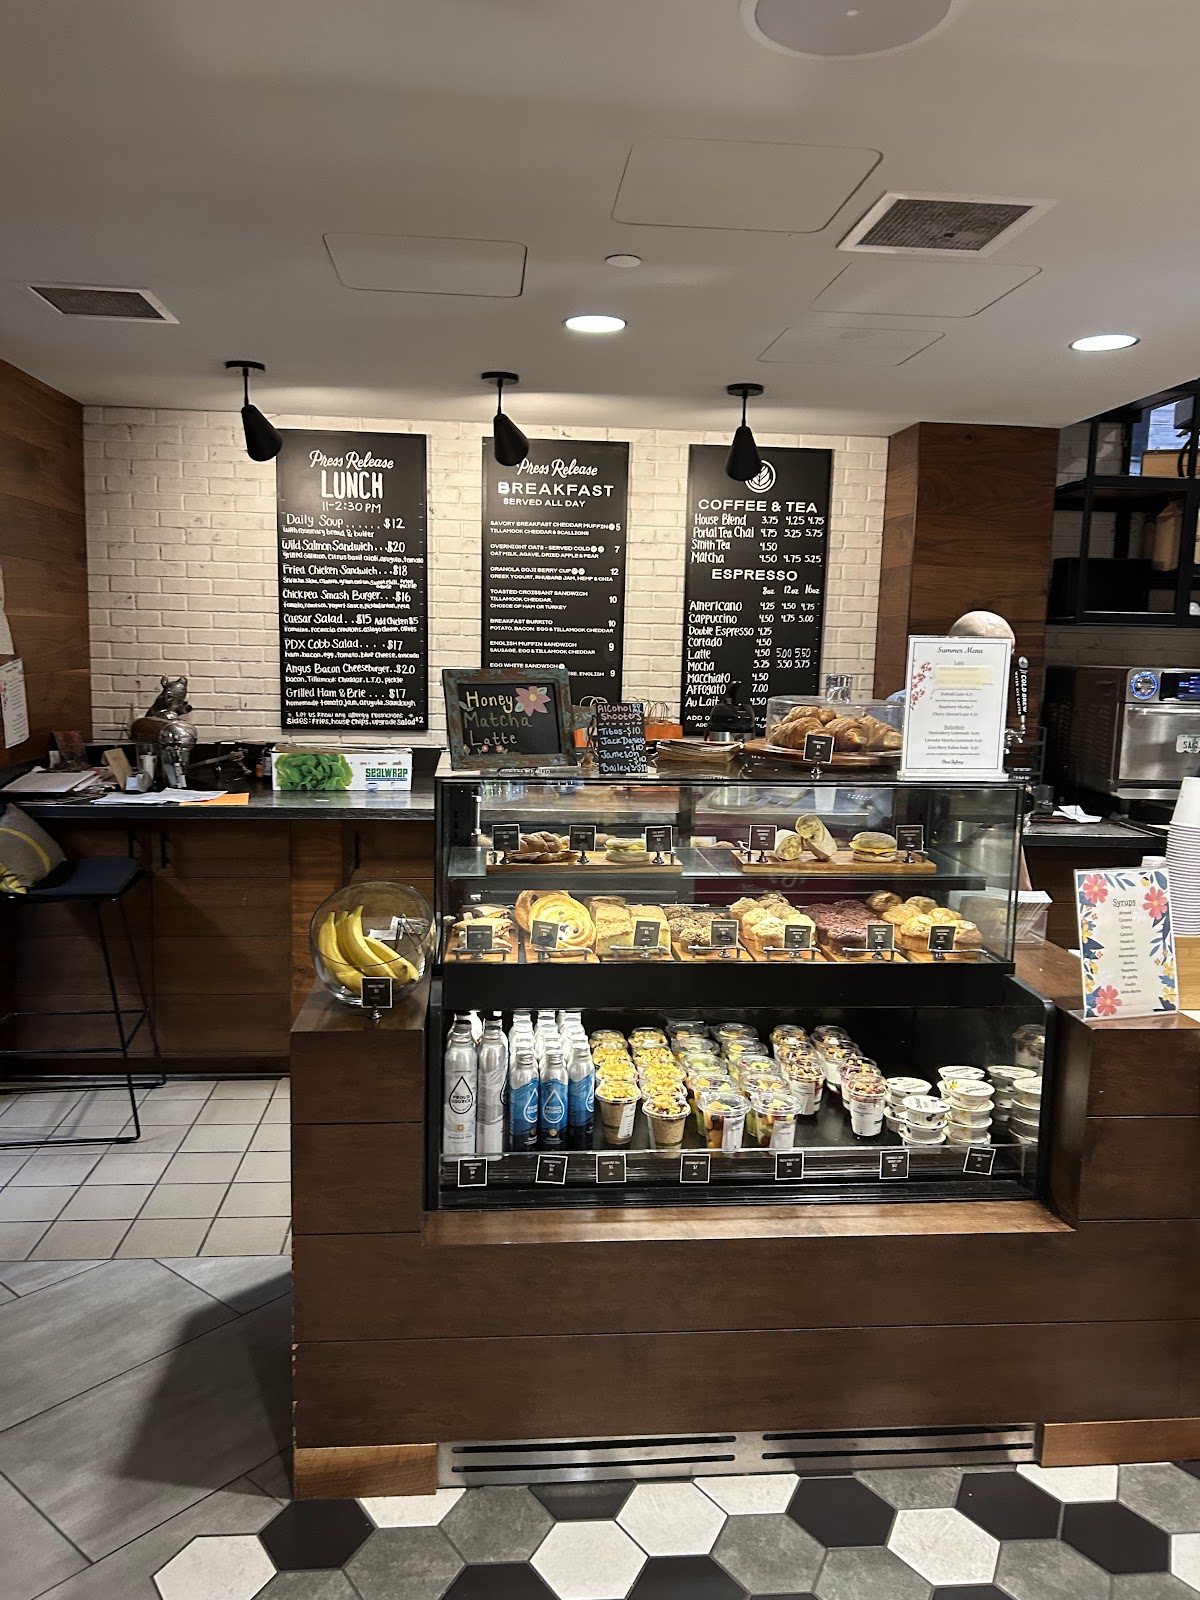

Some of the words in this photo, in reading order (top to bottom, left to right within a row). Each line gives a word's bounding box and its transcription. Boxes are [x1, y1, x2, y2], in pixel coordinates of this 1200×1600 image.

[309, 450, 344, 468] Press
[346, 451, 394, 471] Release
[516, 458, 549, 475] Press
[552, 459, 598, 478] Release
[321, 470, 383, 499] LUNCH
[498, 481, 614, 497] BREAKFAST
[322, 501, 362, 512] 11-2:30
[365, 503, 381, 513] PM
[503, 498, 542, 506] SERVED
[545, 499, 562, 507] ALL
[565, 500, 586, 508] DAY
[698, 499, 767, 512] COFFEE
[771, 501, 782, 512] &
[785, 502, 817, 513] TEA
[287, 514, 314, 527] Daily
[319, 515, 343, 528] Soup
[383, 518, 405, 529] $12
[694, 514, 719, 525] House
[722, 514, 747, 526] Blend
[761, 516, 779, 525] 3.75
[786, 516, 805, 525] 4.25
[808, 516, 825, 525] 4.75
[616, 523, 621, 531] 5
[693, 527, 717, 538] Portal
[718, 527, 732, 538] Tea
[760, 529, 778, 538] 4.75
[783, 529, 802, 538] 5.25
[805, 529, 823, 538] 5.75
[282, 539, 301, 550] Wild
[301, 539, 332, 551] Salmon
[332, 540, 374, 552] Sandwich
[387, 541, 406, 553] $20
[691, 539, 715, 550] Smith
[716, 539, 730, 550] Tea
[760, 542, 778, 551] 4.50
[691, 552, 724, 563] Matcha
[759, 554, 778, 563] 4.50
[783, 554, 801, 563] 4.75
[804, 554, 821, 563] 5.25
[283, 565, 306, 574] Fried
[308, 565, 339, 575] Chicken
[340, 565, 378, 576] Sandwich
[610, 568, 619, 576] 12
[712, 569, 798, 581] ESPRESSO
[762, 587, 775, 595] 8oz
[784, 586, 799, 595] 12oz
[805, 584, 820, 594] 16oz
[282, 589, 318, 600] Chickpea
[320, 589, 350, 600] Smash
[352, 590, 381, 602] Burger
[395, 591, 411, 602] $16
[608, 596, 618, 604] 10
[689, 601, 743, 612] Americano
[760, 602, 775, 611] 4.25
[781, 602, 797, 611] 4.50
[801, 603, 815, 611] 4.75
[283, 614, 312, 624] Caesar
[313, 614, 343, 624] Salad
[355, 614, 372, 624] $15
[409, 616, 419, 625] $5
[608, 620, 616, 628] 10
[689, 614, 737, 625] Cappuccino
[759, 614, 774, 623] 4.50
[781, 614, 795, 622] 4.75
[798, 614, 814, 622] 5.00
[688, 626, 713, 636] Double
[715, 625, 754, 637] Espresso
[758, 627, 772, 636] 4.25
[284, 639, 306, 650] PDX
[308, 639, 331, 649] Cobb
[331, 639, 359, 649] Salad
[387, 640, 403, 651] $17
[608, 642, 614, 651] 9
[688, 637, 722, 648] Cortado
[756, 638, 772, 647] 4.50
[688, 649, 711, 660] Latte
[755, 648, 771, 657] 4.50
[776, 648, 792, 658] 5.00
[795, 648, 811, 658] 5.50
[286, 664, 311, 675] Angus
[314, 664, 340, 673] Bacon
[396, 664, 415, 674] $20
[688, 660, 715, 671] Mocha
[753, 660, 770, 669] 5.25
[776, 660, 792, 669] 5.50
[794, 660, 810, 668] 5.75
[687, 673, 730, 684] Macchiato
[752, 673, 769, 681] 4.50
[286, 688, 315, 698] Grilled
[317, 688, 337, 698] Ham
[339, 688, 346, 698] &
[347, 688, 366, 698] Brie
[389, 688, 406, 699] $17
[751, 684, 769, 693] 7.00
[466, 690, 513, 714] Honey
[685, 697, 698, 708] Au
[699, 697, 720, 707] Lait
[750, 697, 766, 706] 4.50
[597, 705, 632, 713] Alcohol
[464, 711, 533, 728] Matcha
[600, 713, 642, 721] Shooters
[470, 730, 517, 746] Latte
[600, 737, 622, 745] Jack
[599, 750, 640, 759] Jameson
[1112, 899, 1136, 907] Syrups
